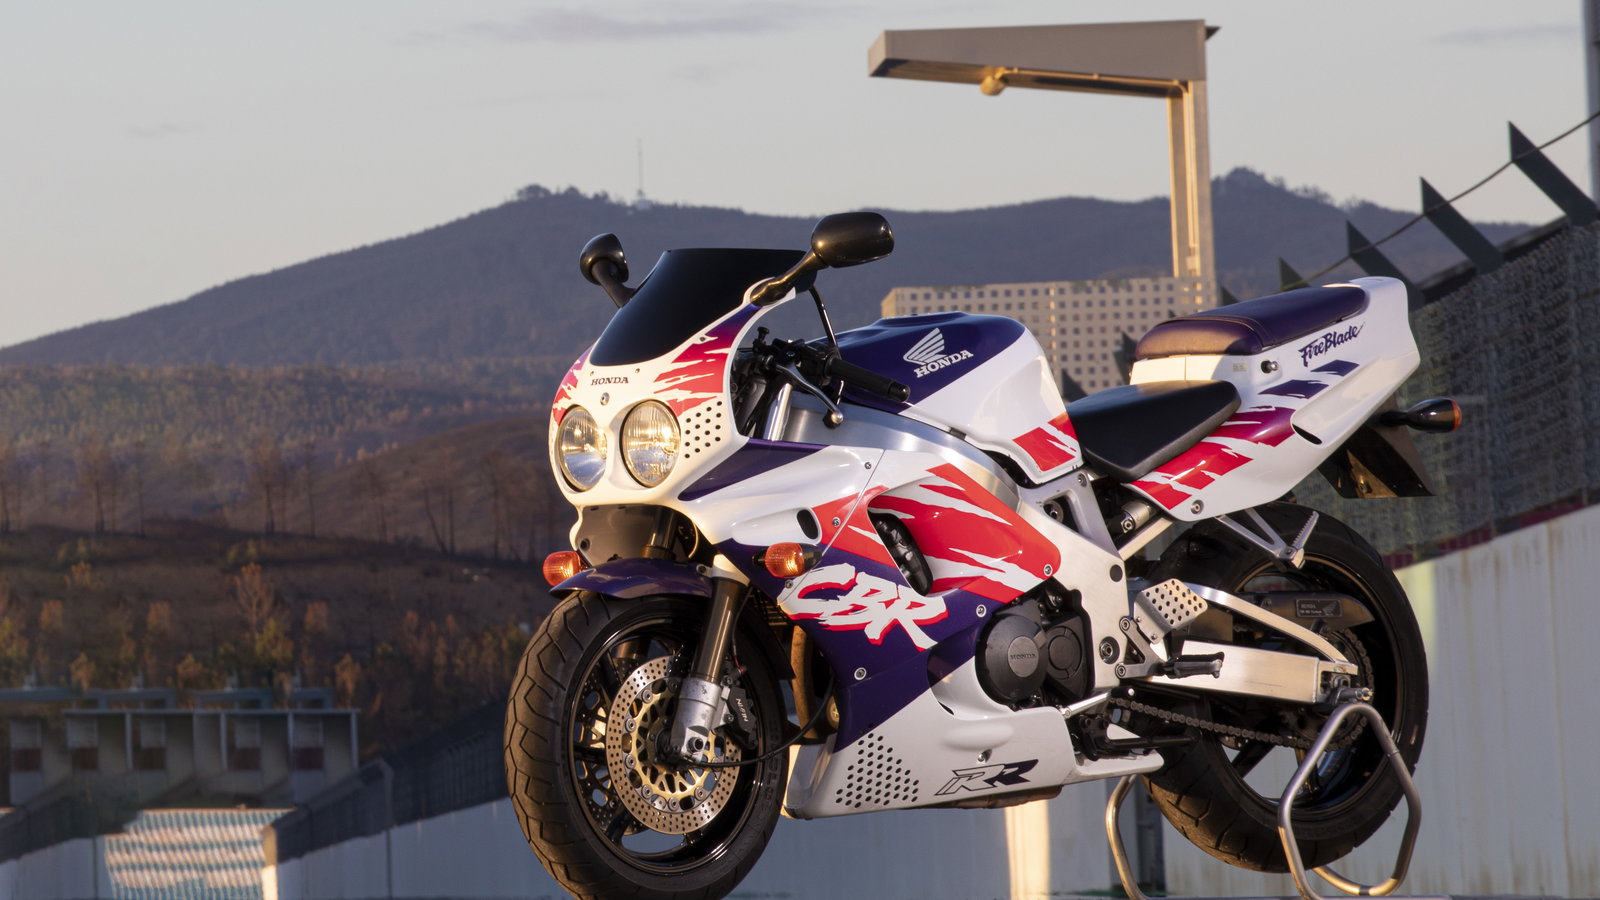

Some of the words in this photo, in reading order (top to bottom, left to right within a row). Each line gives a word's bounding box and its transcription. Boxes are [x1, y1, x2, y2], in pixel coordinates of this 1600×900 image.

[1298, 321, 1365, 367] FireBlade
[590, 376, 629, 386] HONDA
[913, 349, 974, 378] HONDA
[776, 562, 948, 652] CBR
[934, 759, 1039, 796] RR
